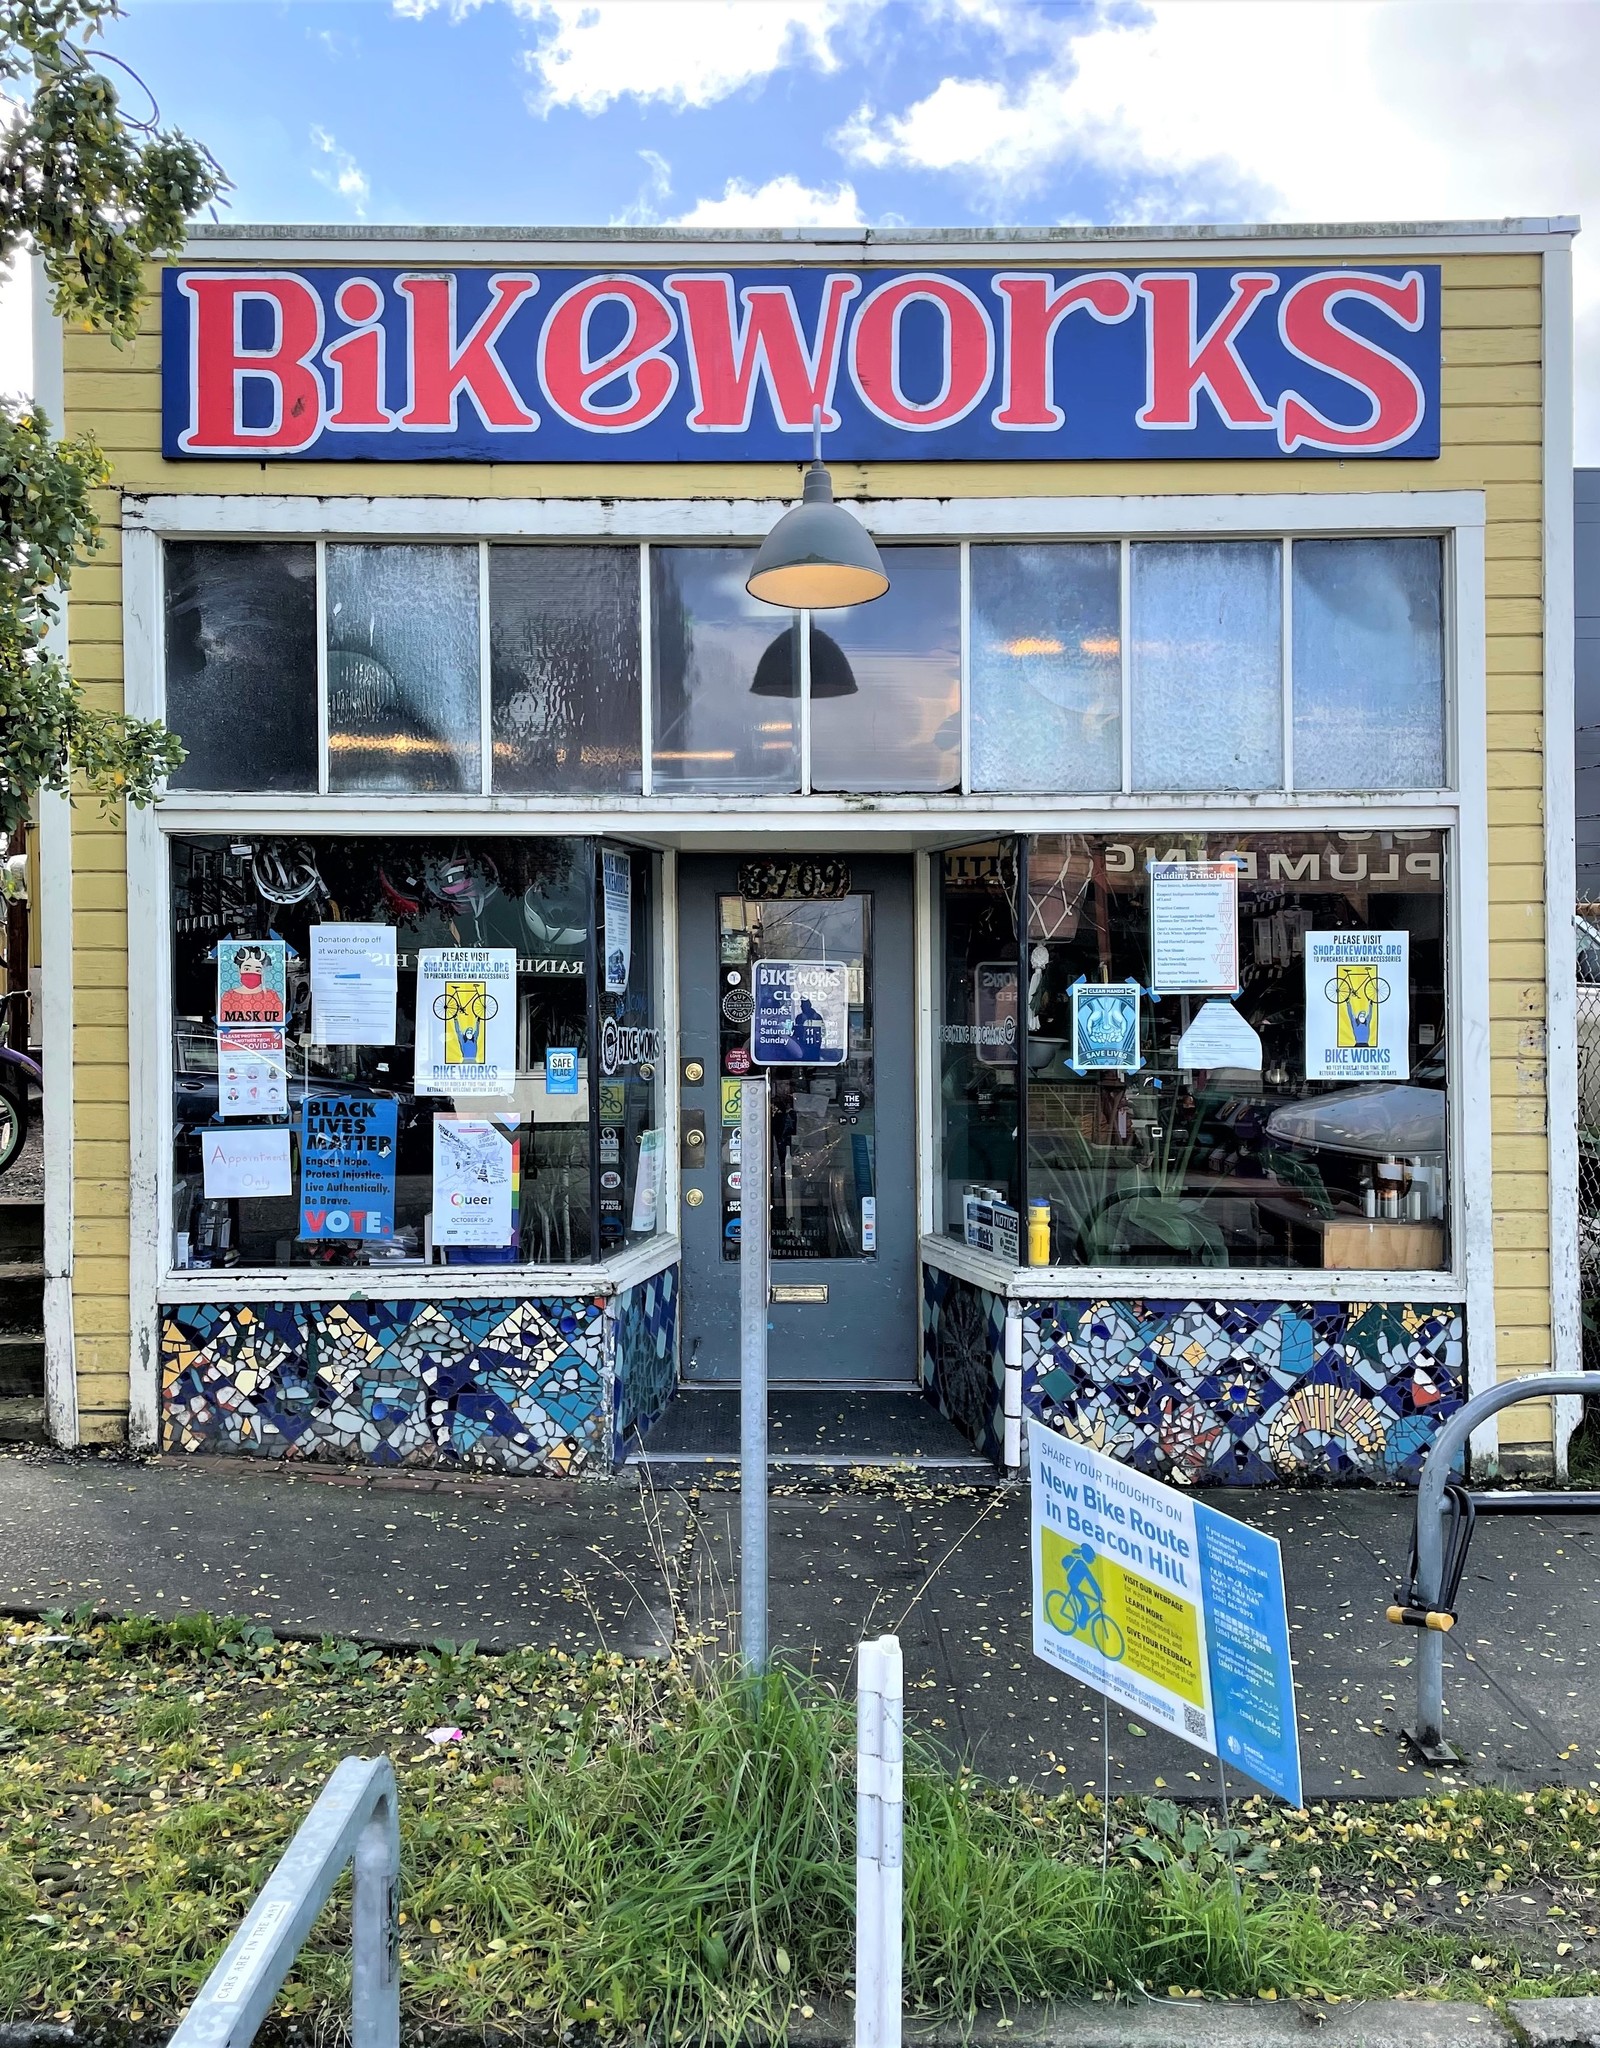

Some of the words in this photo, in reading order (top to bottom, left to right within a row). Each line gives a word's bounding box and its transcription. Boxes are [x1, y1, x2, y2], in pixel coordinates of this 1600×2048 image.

[742, 861, 841, 898] 3709
[1154, 871, 1189, 880] Guiding
[1189, 871, 1235, 880] Principles
[352, 936, 370, 944] drop
[1334, 935, 1360, 944] PLEASE
[1362, 935, 1382, 944] VISIT
[442, 952, 468, 962] PLEASE
[470, 952, 490, 961] VISIT
[1314, 945, 1402, 955] SHOP.BIKEWORKS.ORG
[424, 962, 510, 972] SHOP.BIKEWORKS.ORG
[760, 969, 796, 986] BIKE
[798, 972, 840, 987] WORKS
[774, 990, 828, 1000] CLOSED
[225, 1010, 260, 1022] MASK
[264, 1010, 280, 1022] UP
[732, 1010, 748, 1018] RIDE
[760, 1028, 794, 1036] Saturday
[618, 1027, 638, 1064] BIKE
[638, 1028, 660, 1064] WORKS
[760, 1037, 789, 1046] Sunday
[1106, 1050, 1128, 1058] LIVES
[1325, 1049, 1348, 1063] BIKE
[1351, 1049, 1390, 1063] WORKS
[552, 1058, 572, 1068] SAFE
[433, 1065, 456, 1080] BIKE
[459, 1065, 498, 1080] WORKS
[308, 1102, 376, 1117] BLACK
[308, 1118, 366, 1134] LIVES
[307, 1135, 392, 1150] MATTER
[211, 1146, 288, 1168] Appointment
[306, 1157, 340, 1168] Engage
[344, 1157, 370, 1168] Hope.
[242, 1174, 270, 1190] Only
[306, 1170, 339, 1178] Protest
[342, 1170, 384, 1180] Injustice.
[306, 1182, 324, 1192] Live
[327, 1182, 390, 1195] Authentically.
[304, 1196, 317, 1204] Be
[320, 1196, 350, 1204] Brave.
[451, 1193, 492, 1208] Queer
[305, 1210, 390, 1234] VOTE.
[994, 1212, 1018, 1232] NOTICE
[1042, 1442, 1071, 1468] SHARE
[1074, 1459, 1102, 1482] YOUR
[1105, 1474, 1163, 1513] THOUGHTS
[1166, 1506, 1182, 1522] ON
[1040, 1462, 1078, 1501] New
[1083, 1484, 1126, 1525] Bike
[1130, 1507, 1190, 1558] Route
[1046, 1494, 1062, 1524] in
[1067, 1506, 1143, 1564] Beacon
[1149, 1546, 1188, 1588] Hill
[1123, 1574, 1139, 1588] VISIT
[1140, 1582, 1152, 1594] OUR
[1153, 1590, 1184, 1613] WEBPAGE
[1124, 1596, 1145, 1613] LEARN
[1146, 1608, 1164, 1622] MORE
[1126, 1626, 1140, 1640] GIVE
[1142, 1634, 1158, 1649] YOUR
[1160, 1644, 1192, 1668] FEEDBACK
[218, 1976, 238, 1998] CARS
[234, 1956, 250, 1972] ARE
[245, 1940, 258, 1950] IN
[253, 1922, 270, 1937] THE
[264, 1904, 280, 1918] WAY
